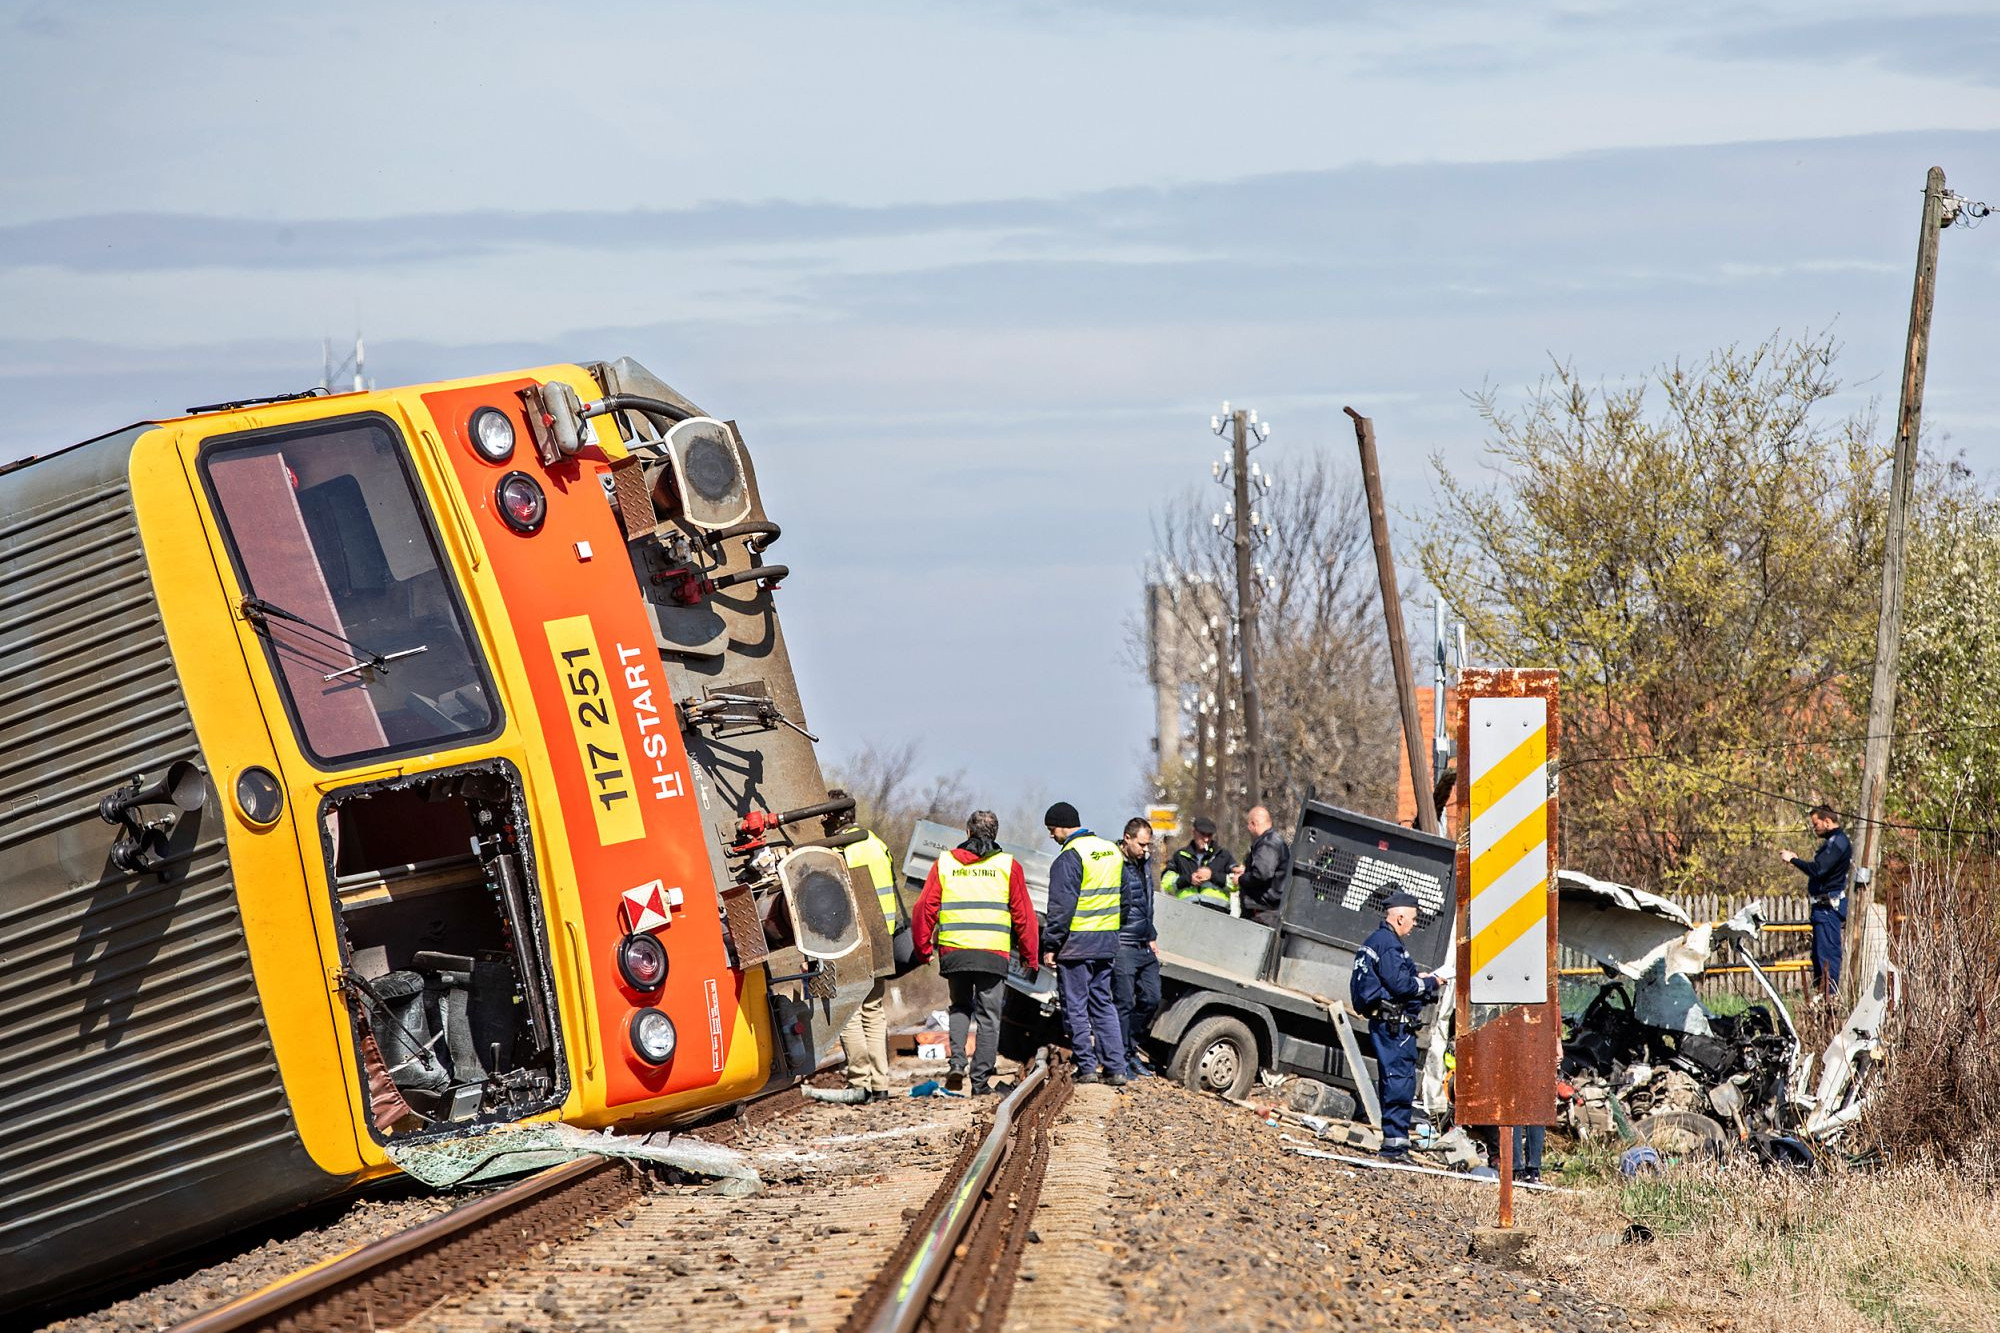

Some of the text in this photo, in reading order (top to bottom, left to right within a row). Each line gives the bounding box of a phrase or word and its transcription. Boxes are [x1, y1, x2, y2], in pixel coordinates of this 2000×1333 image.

[561, 647, 628, 811] 117 251
[616, 643, 685, 799] H-START
